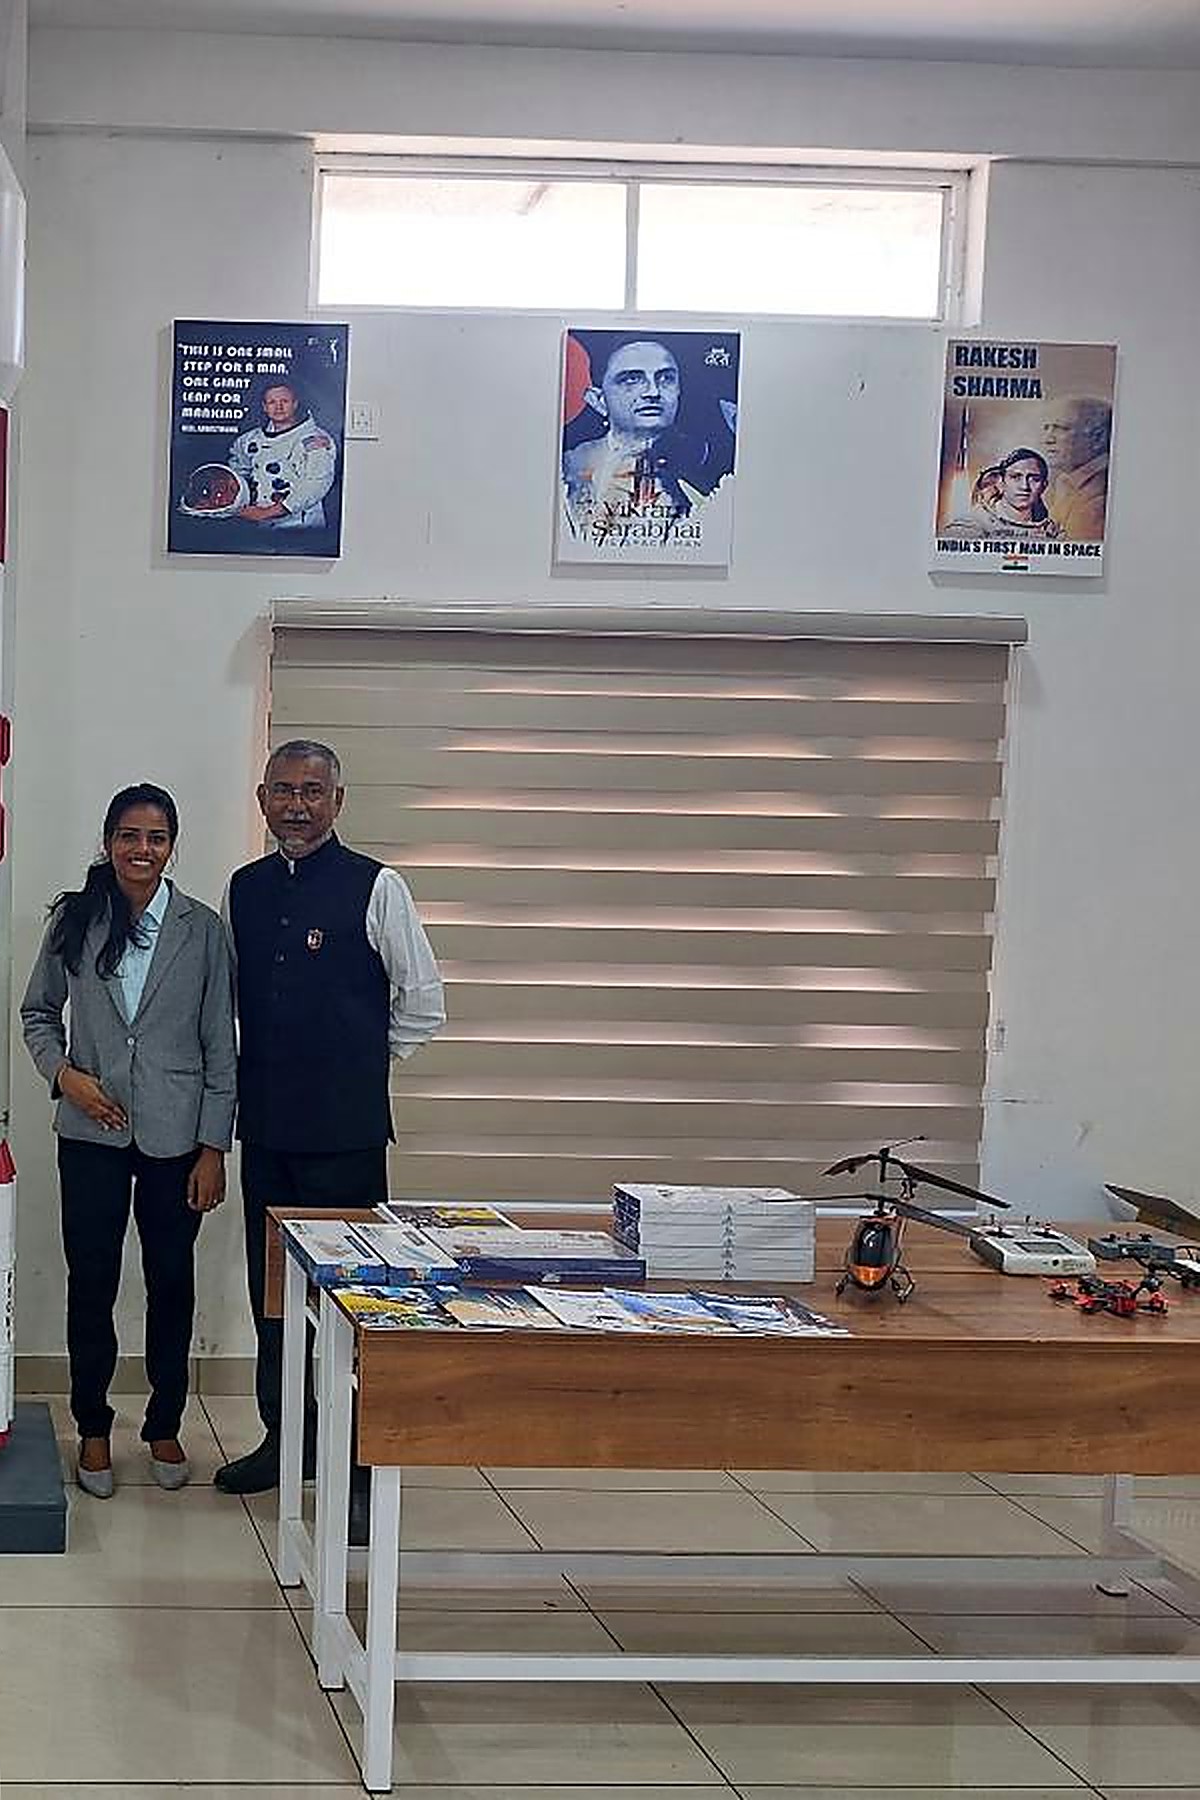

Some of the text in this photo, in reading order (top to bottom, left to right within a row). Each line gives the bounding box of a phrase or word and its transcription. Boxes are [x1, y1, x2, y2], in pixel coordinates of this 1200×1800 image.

[212, 345, 223, 357] IS
[226, 346, 253, 358] ONE
[256, 347, 293, 359] SMALL
[955, 345, 1037, 369] RAKESH
[183, 361, 213, 372] STEP
[215, 361, 243, 373] FOR
[245, 362, 254, 373] A
[182, 376, 251, 389] ONE GIANT
[953, 375, 1042, 399] SHARMA
[182, 391, 241, 404] LEAP FOR
[591, 519, 701, 539] Sarabhai
[937, 539, 1101, 557] INDIA'S FIRST MAN IN SPACE
